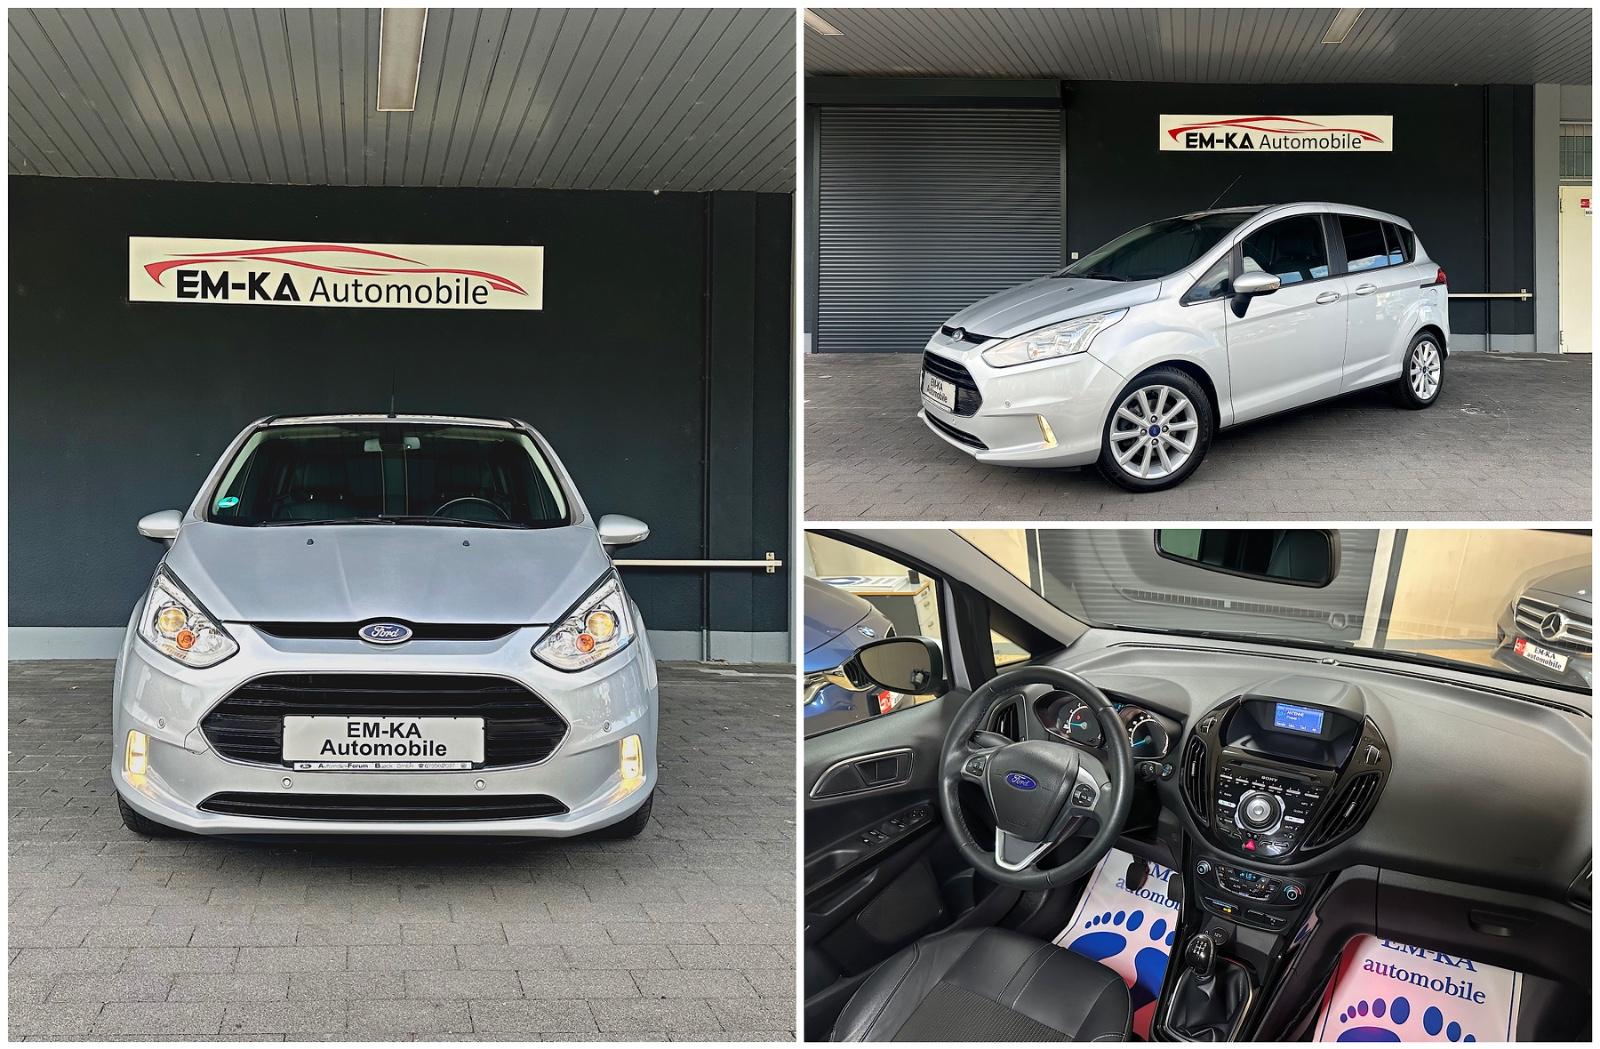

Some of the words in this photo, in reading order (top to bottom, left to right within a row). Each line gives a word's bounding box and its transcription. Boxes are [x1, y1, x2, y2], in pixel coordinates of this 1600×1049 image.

[1185, 132, 1254, 149] EM-KA
[1259, 133, 1362, 149] Automobile
[176, 269, 300, 302] EM-KA
[310, 276, 488, 305] Automobile
[371, 625, 399, 638] Ford
[1527, 652, 1562, 670] automobile
[1534, 646, 1556, 660] EM-KA
[347, 721, 422, 739] EM-KA
[320, 739, 447, 757] Automobile
[1011, 774, 1031, 787] Ford
[1363, 958, 1486, 1005] automobile
